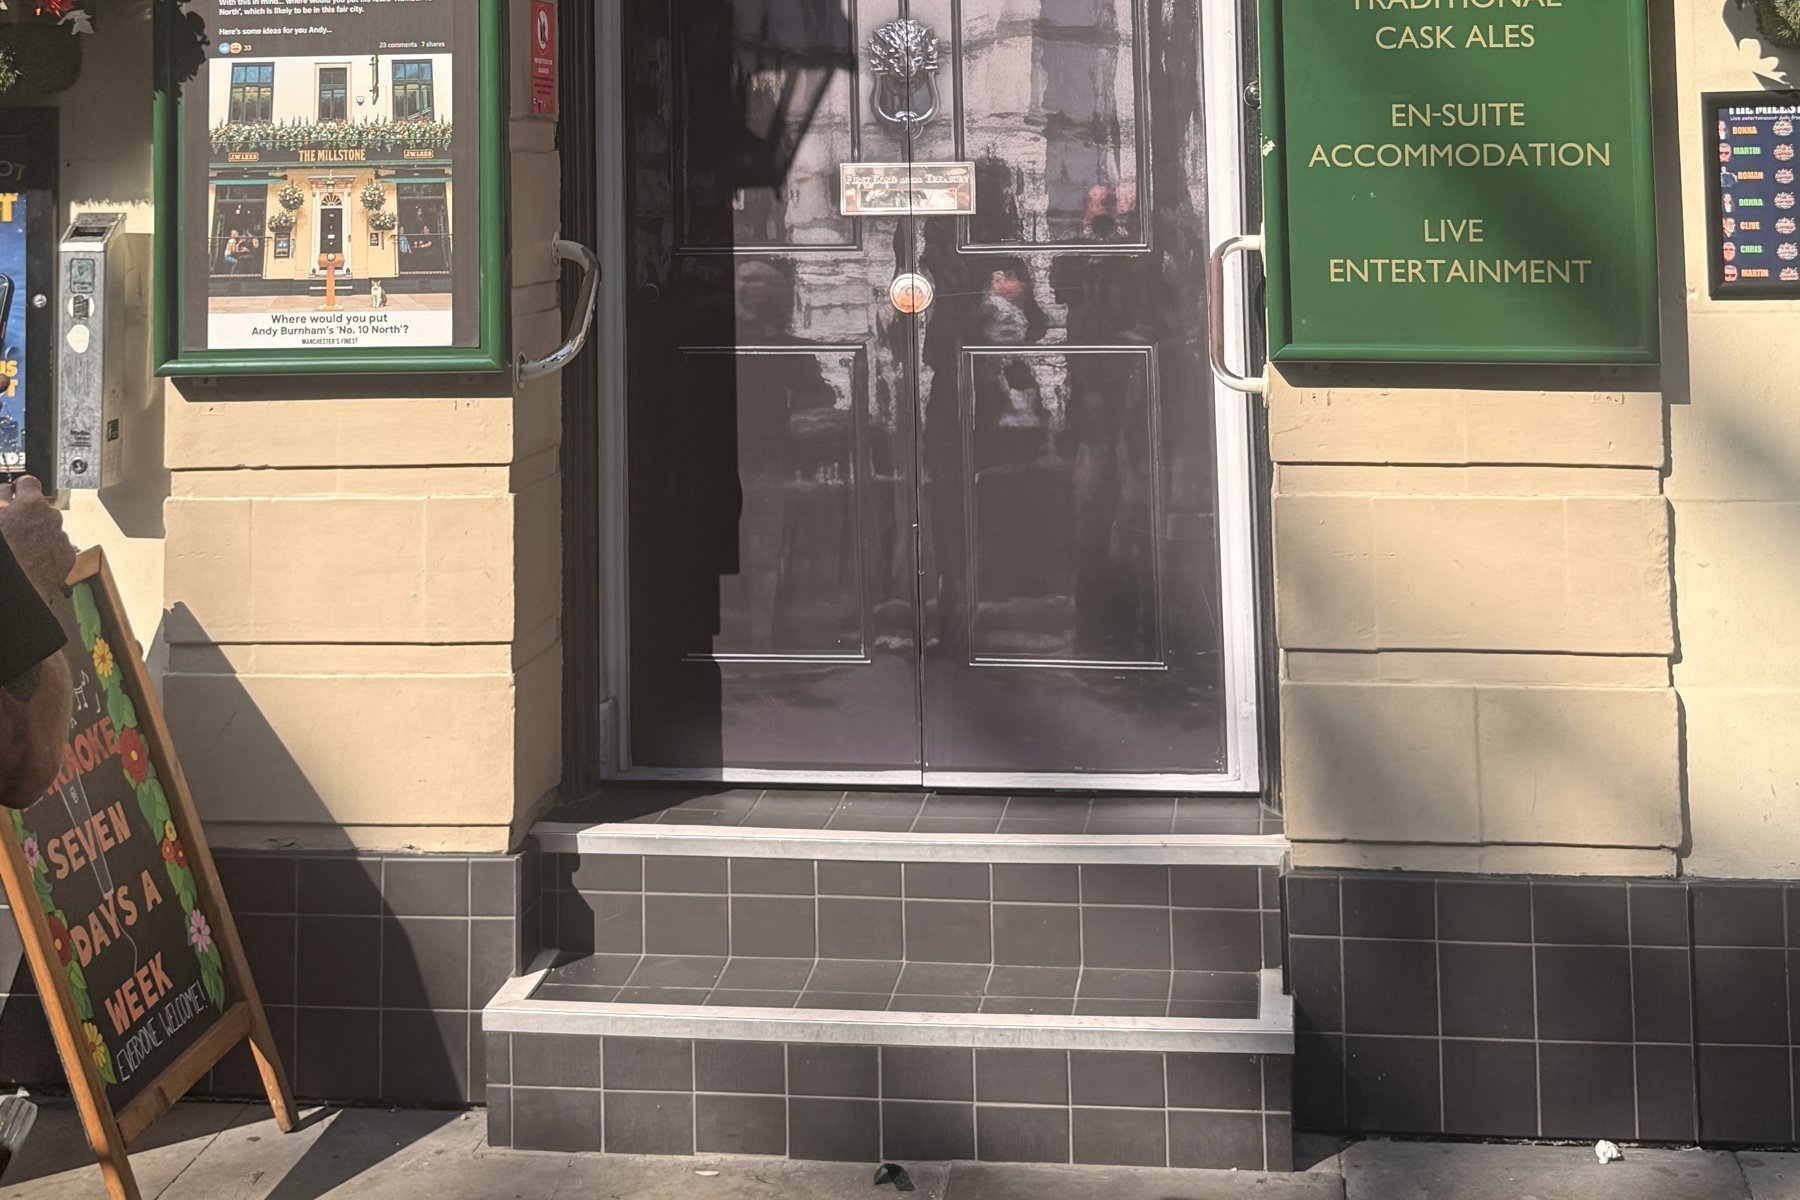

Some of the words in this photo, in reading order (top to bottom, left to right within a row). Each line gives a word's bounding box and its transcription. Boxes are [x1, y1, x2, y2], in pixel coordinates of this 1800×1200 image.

[244, 7, 266, 15] which
[274, 6, 292, 15] likely
[303, 6, 312, 14] be
[321, 5, 335, 13] this
[336, 5, 348, 13] fair
[349, 5, 364, 14] city.
[219, 27, 241, 35] Here's
[282, 26, 293, 34] for
[294, 27, 307, 35] you
[1375, 24, 1457, 50] CASK
[1464, 23, 1536, 49] ALES
[1391, 103, 1525, 127] EN-SUITE
[299, 150, 315, 161] THE
[317, 149, 366, 161] MILLSTONE
[1308, 142, 1611, 168] ACCOMMODATION
[1423, 219, 1484, 243] LIVE
[1740, 245, 1763, 253] CHRIS
[1328, 259, 1592, 285] ENTERTAINMENT
[252, 327, 278, 337] Andy
[280, 326, 335, 335] Burnham's
[357, 325, 369, 334] 10
[271, 314, 307, 324] Where
[309, 314, 343, 323] would
[345, 315, 367, 325] you
[368, 313, 388, 325] put
[47, 801, 132, 880] SEVEN
[69, 885, 138, 968] DAYS
[140, 869, 163, 912] A
[104, 951, 174, 1036] WEEK
[116, 1017, 164, 1082] EVERYONE
[157, 979, 209, 1038] WELCOME!
